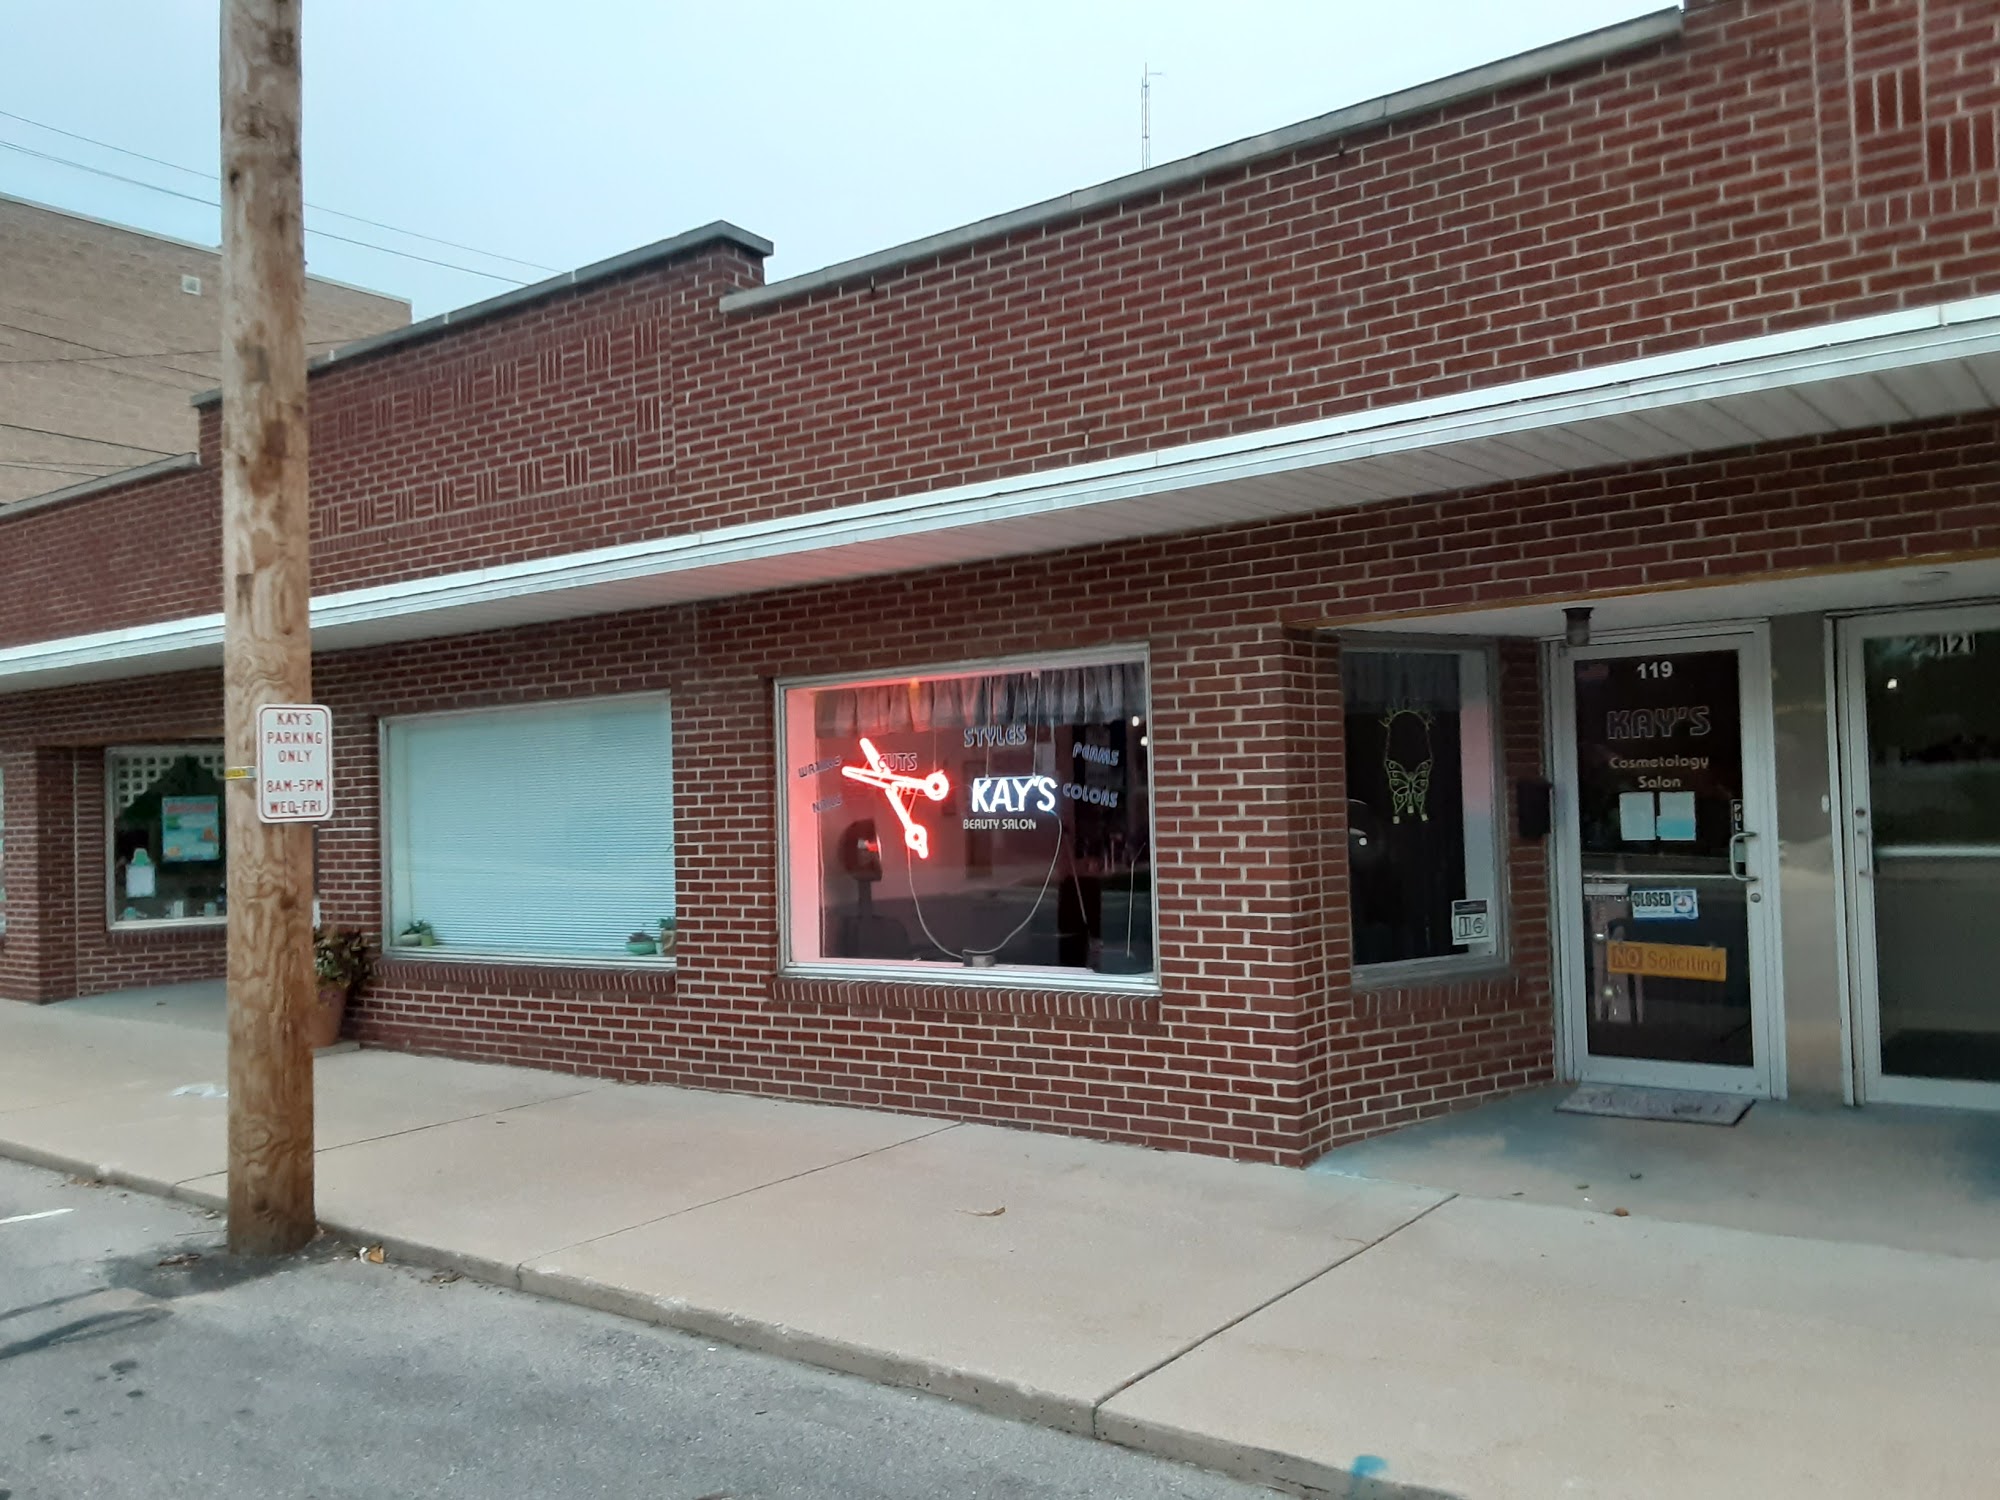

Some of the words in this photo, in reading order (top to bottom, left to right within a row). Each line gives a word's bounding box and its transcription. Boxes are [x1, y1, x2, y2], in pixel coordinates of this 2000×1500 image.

[1637, 661, 1673, 679] 119
[276, 713, 313, 726] KAY'S
[1606, 705, 1711, 740] KAY'S
[267, 731, 323, 744] PARKING
[963, 724, 1027, 748] STYLES
[278, 750, 313, 763] ONLY
[878, 752, 918, 772] CUTS
[1072, 741, 1120, 766] PERMS
[1609, 754, 1710, 770] Cosmetology
[266, 779, 324, 793] 8AM-5PM
[1638, 775, 1681, 789] Salon
[971, 775, 1058, 813] KAY'S
[1062, 782, 1119, 809] COLORS
[962, 818, 999, 830] BEAUTY
[1001, 818, 1037, 830] SALON
[1733, 803, 1742, 834] PUL
[1633, 891, 1671, 907] CLOSED
[1612, 946, 1640, 969] NO
[1647, 950, 1721, 976] Soliciting
